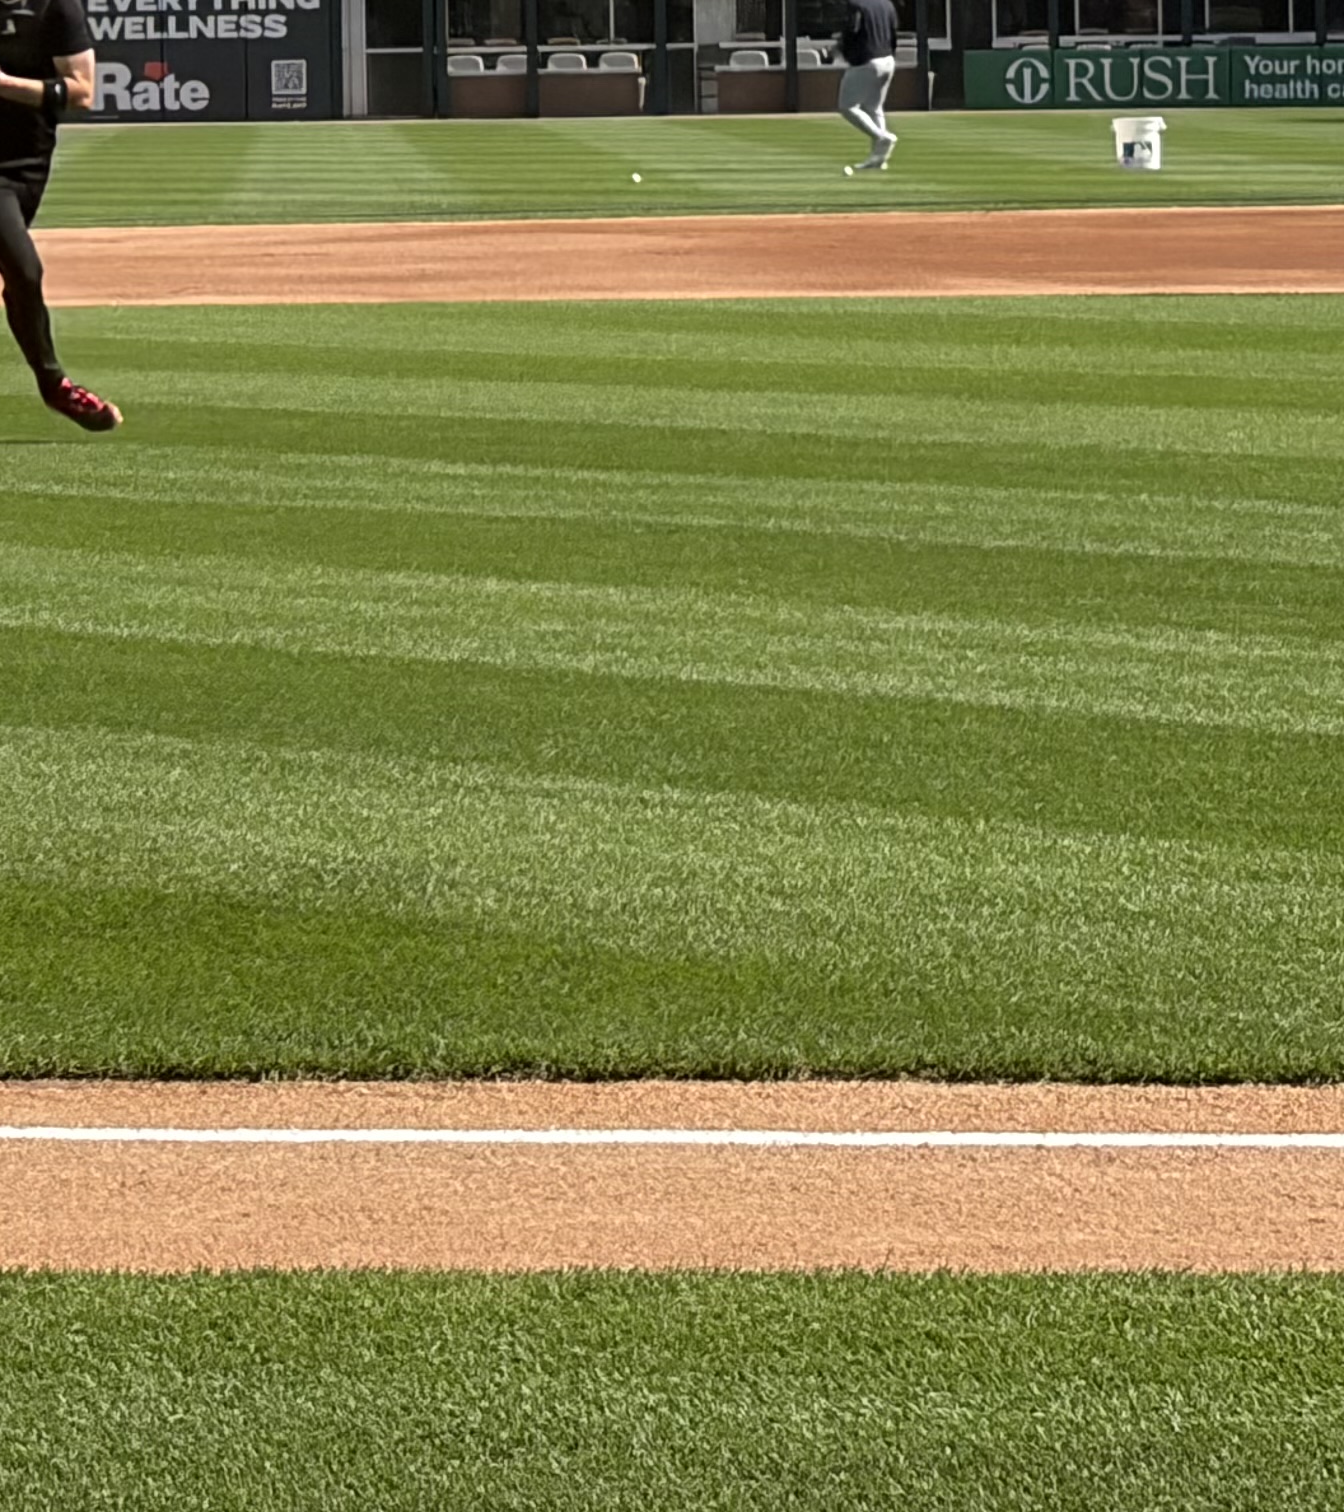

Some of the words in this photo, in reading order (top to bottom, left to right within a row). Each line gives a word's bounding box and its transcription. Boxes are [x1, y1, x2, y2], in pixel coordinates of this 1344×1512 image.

[87, 14, 288, 41] WELLNESS
[1243, 54, 1300, 75] Your
[92, 61, 210, 111] Rate
[1065, 55, 1221, 102] RUSH
[1244, 79, 1320, 99] health
